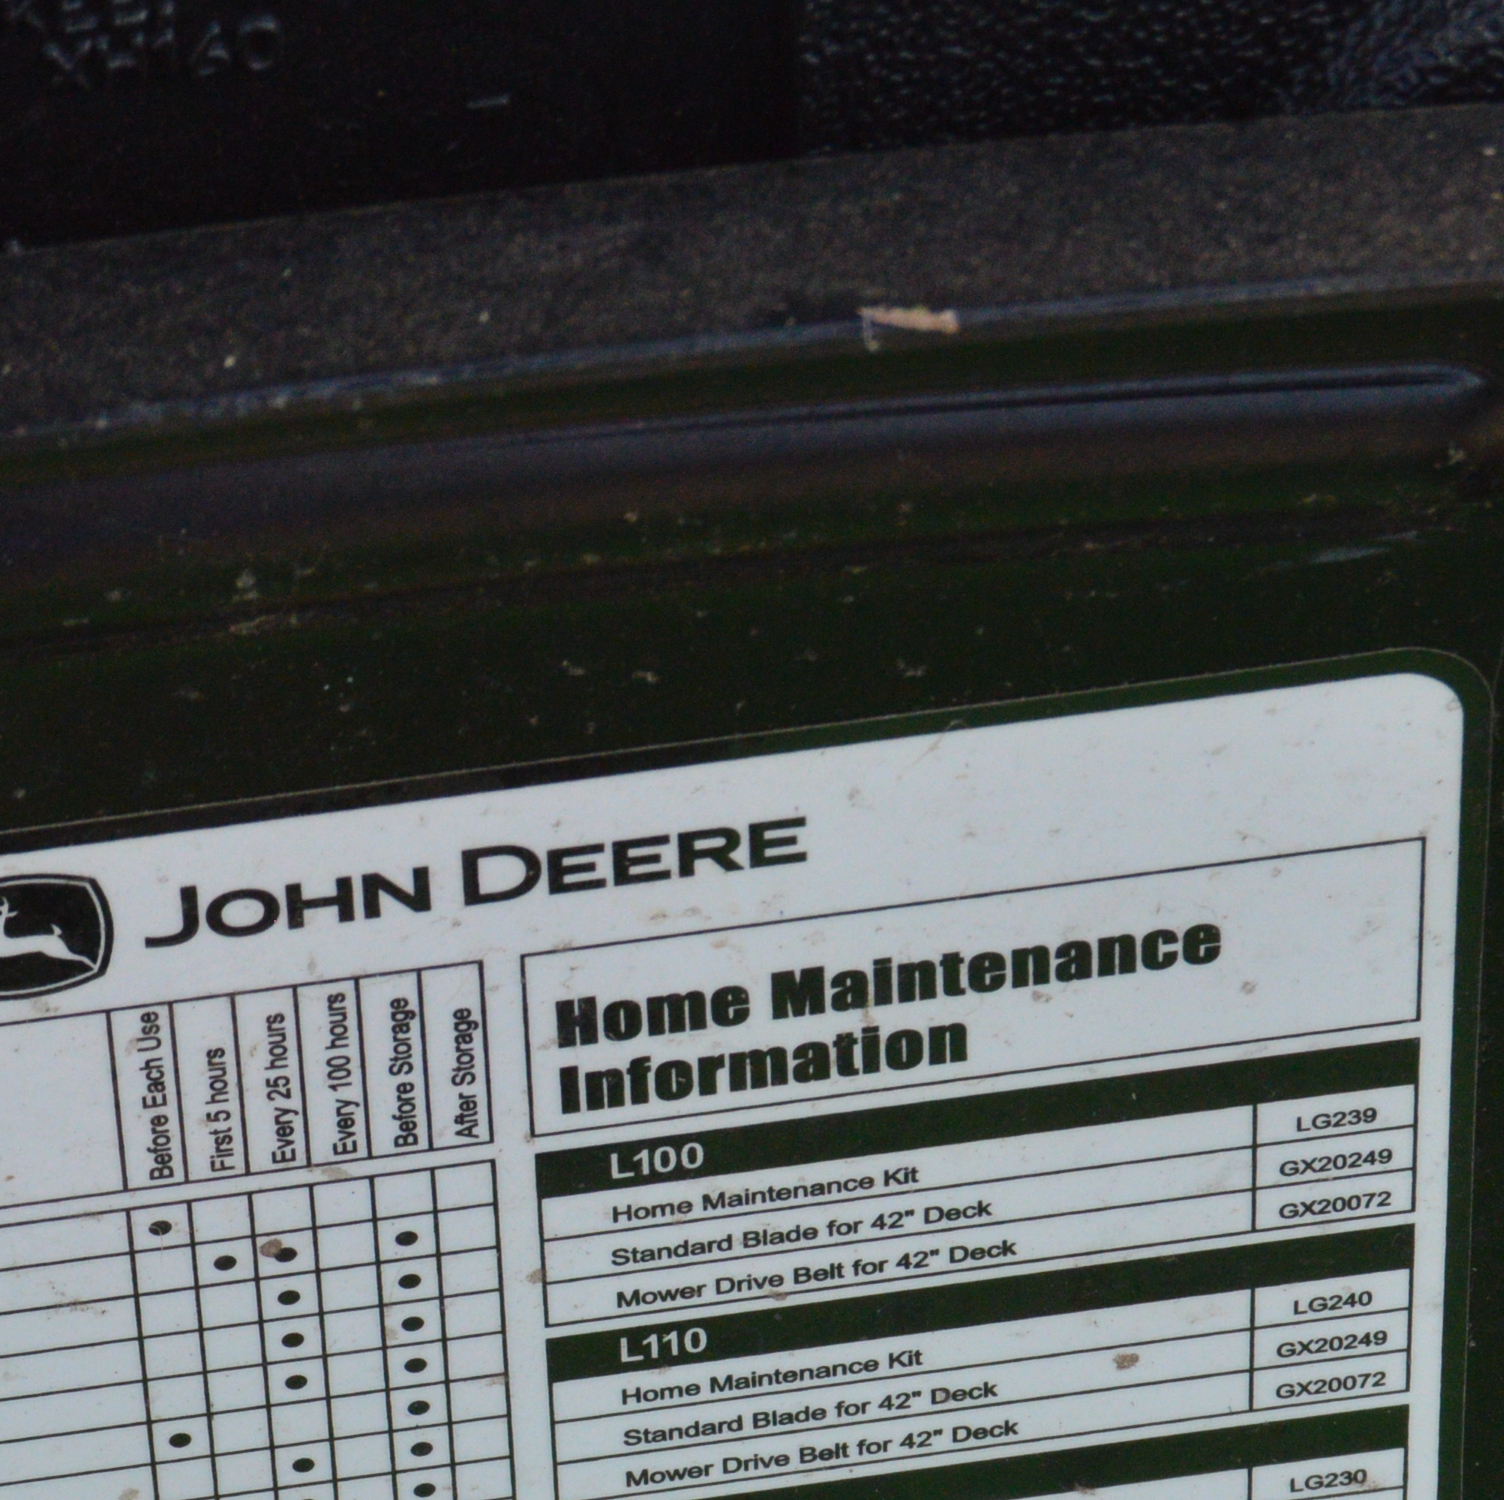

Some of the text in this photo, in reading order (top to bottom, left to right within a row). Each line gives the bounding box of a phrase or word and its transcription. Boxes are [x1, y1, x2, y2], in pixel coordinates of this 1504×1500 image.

[143, 815, 807, 949] JOHN DEERE
[554, 922, 1221, 1049] Home Maintenance
[135, 1010, 175, 1181] Before Each Use
[263, 1011, 297, 1164] Every 25 hours
[324, 991, 359, 1156] Every 100 hours
[387, 996, 419, 1148] Before Storage
[449, 1006, 479, 1139] After Storage
[558, 1021, 968, 1115] Information
[204, 1046, 236, 1173] First 5 hours
[1295, 1106, 1378, 1133] LG239
[609, 1141, 704, 1179] L100
[1277, 1147, 1395, 1179] GX20249
[611, 1165, 920, 1224] Home Maintenance Kit
[1276, 1190, 1394, 1222] GX20072
[610, 1232, 733, 1267] Standard
[741, 1223, 819, 1249] Blade
[825, 1218, 864, 1238] for
[922, 1198, 993, 1225] Deck
[615, 1282, 707, 1309] Mower
[714, 1272, 785, 1296] Drive
[792, 1261, 845, 1285] Belt
[850, 1257, 889, 1277] for
[947, 1238, 1017, 1264] Deck
[1292, 1289, 1373, 1316] LG240
[619, 1326, 707, 1363] L110
[620, 1348, 923, 1406] Home Maintenance Kit
[1275, 1329, 1388, 1359] GX20249
[622, 1413, 744, 1447] Standard
[751, 1404, 827, 1430] Blade
[833, 1399, 872, 1418] for
[929, 1380, 998, 1405] Deck
[1273, 1369, 1388, 1402] GX20072
[624, 1462, 715, 1488] Mower
[721, 1452, 791, 1475] Drive
[797, 1441, 850, 1465] Belt
[855, 1437, 893, 1456] for
[951, 1418, 1019, 1444] Deck
[1288, 1467, 1368, 1493] LG230
